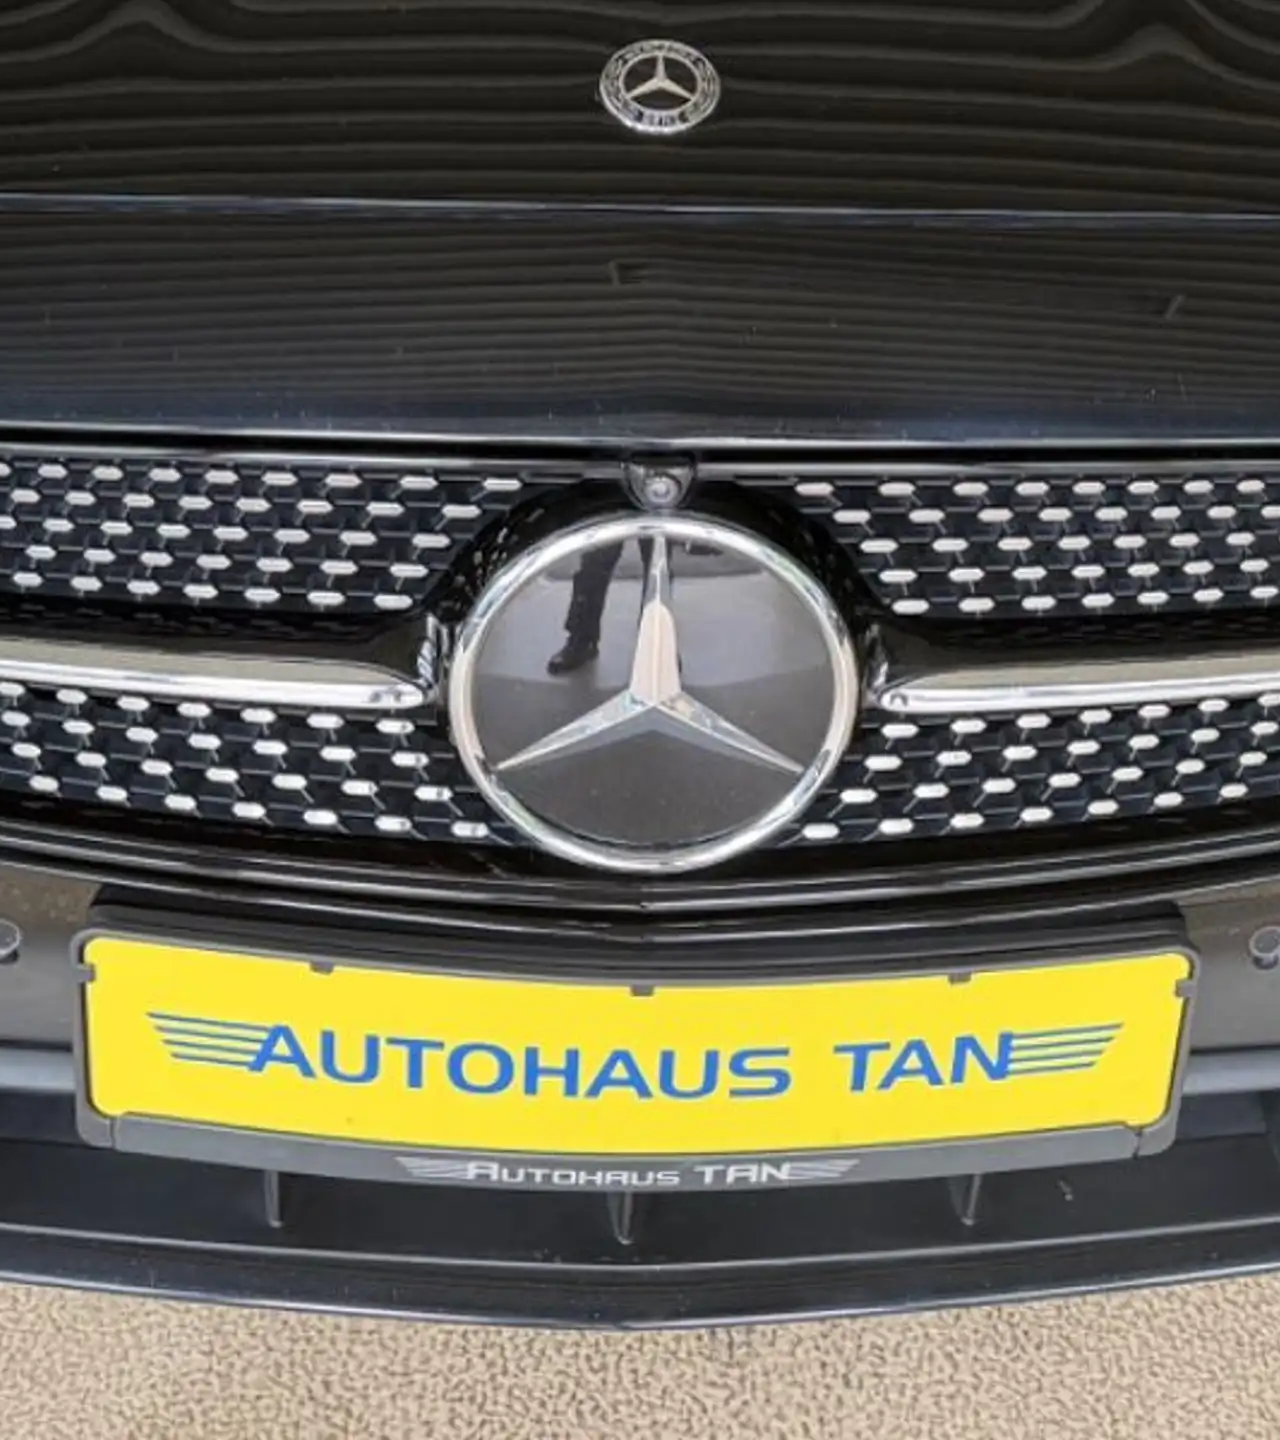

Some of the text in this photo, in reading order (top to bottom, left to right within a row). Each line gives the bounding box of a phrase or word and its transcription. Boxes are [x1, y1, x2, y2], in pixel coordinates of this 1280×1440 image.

[247, 1024, 1013, 1100] AUTOHAUS TAN
[466, 1160, 791, 1187] AUTOHAUS TAN
